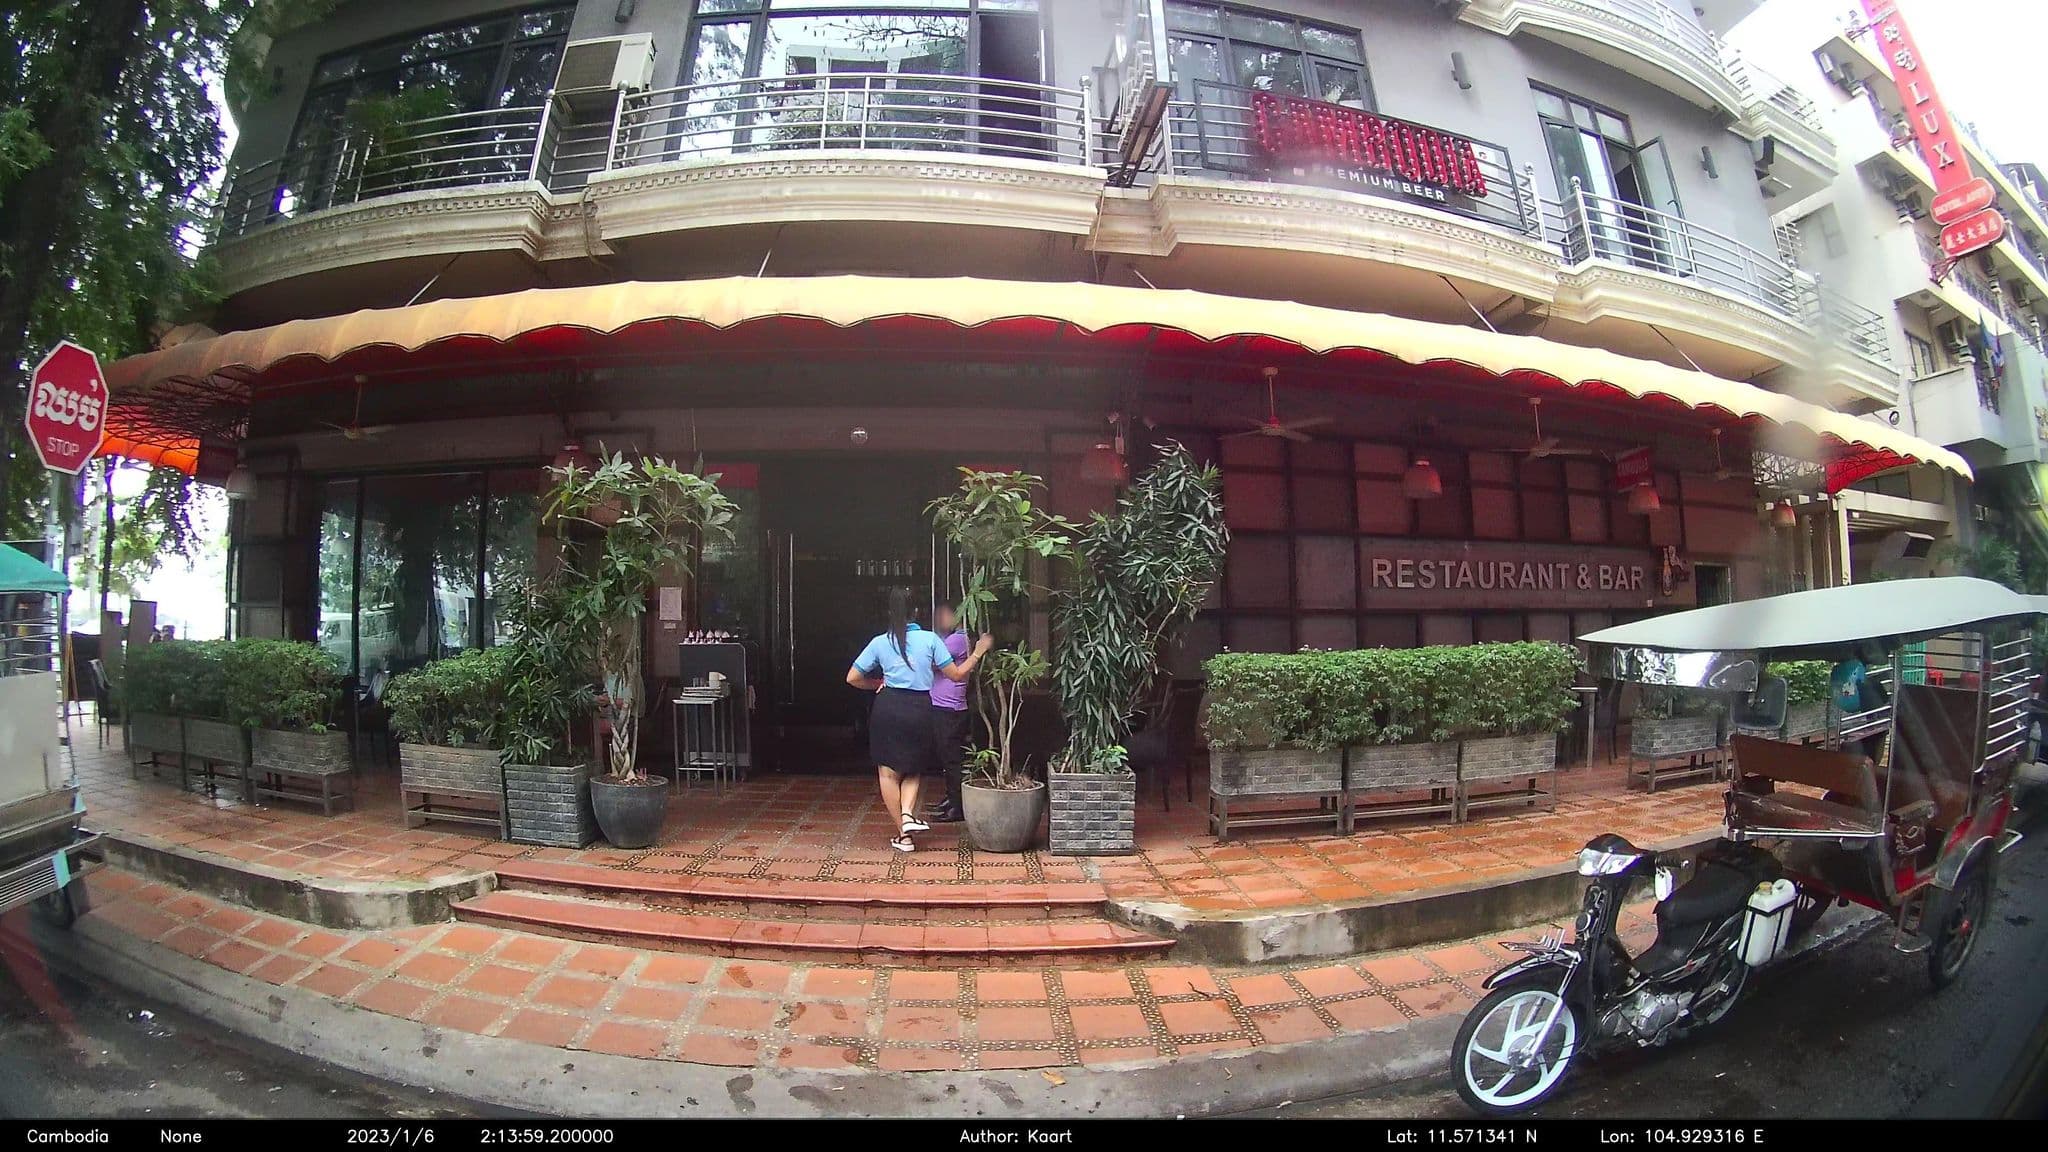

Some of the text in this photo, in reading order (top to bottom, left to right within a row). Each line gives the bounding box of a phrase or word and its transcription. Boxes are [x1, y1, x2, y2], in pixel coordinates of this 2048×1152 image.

[1908, 81, 1955, 170] LUX
[1402, 182, 1446, 201] BEER
[47, 436, 80, 457] STOP
[1371, 557, 1645, 591] RESTAURANT & BAR
